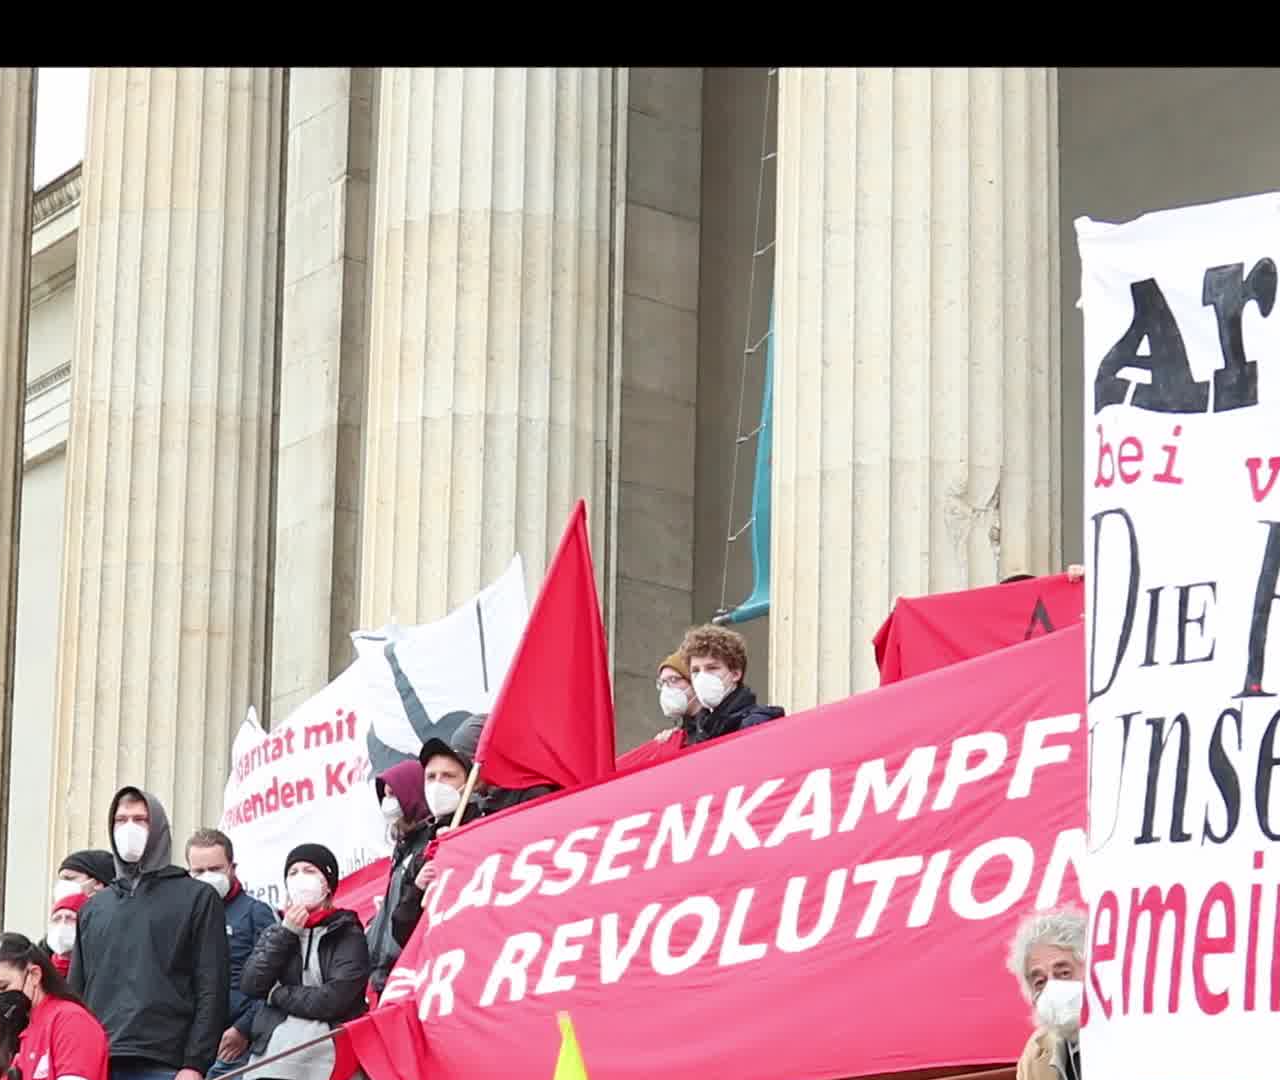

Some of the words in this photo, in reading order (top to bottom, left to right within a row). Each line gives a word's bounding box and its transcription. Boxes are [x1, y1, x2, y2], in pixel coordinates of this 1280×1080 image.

[1094, 425, 1184, 489] bei
[1088, 508, 1218, 703] DIE
[304, 708, 357, 750] mit
[424, 714, 1081, 936] LASSENKAMPF
[479, 828, 1088, 1009] REVOLUTION
